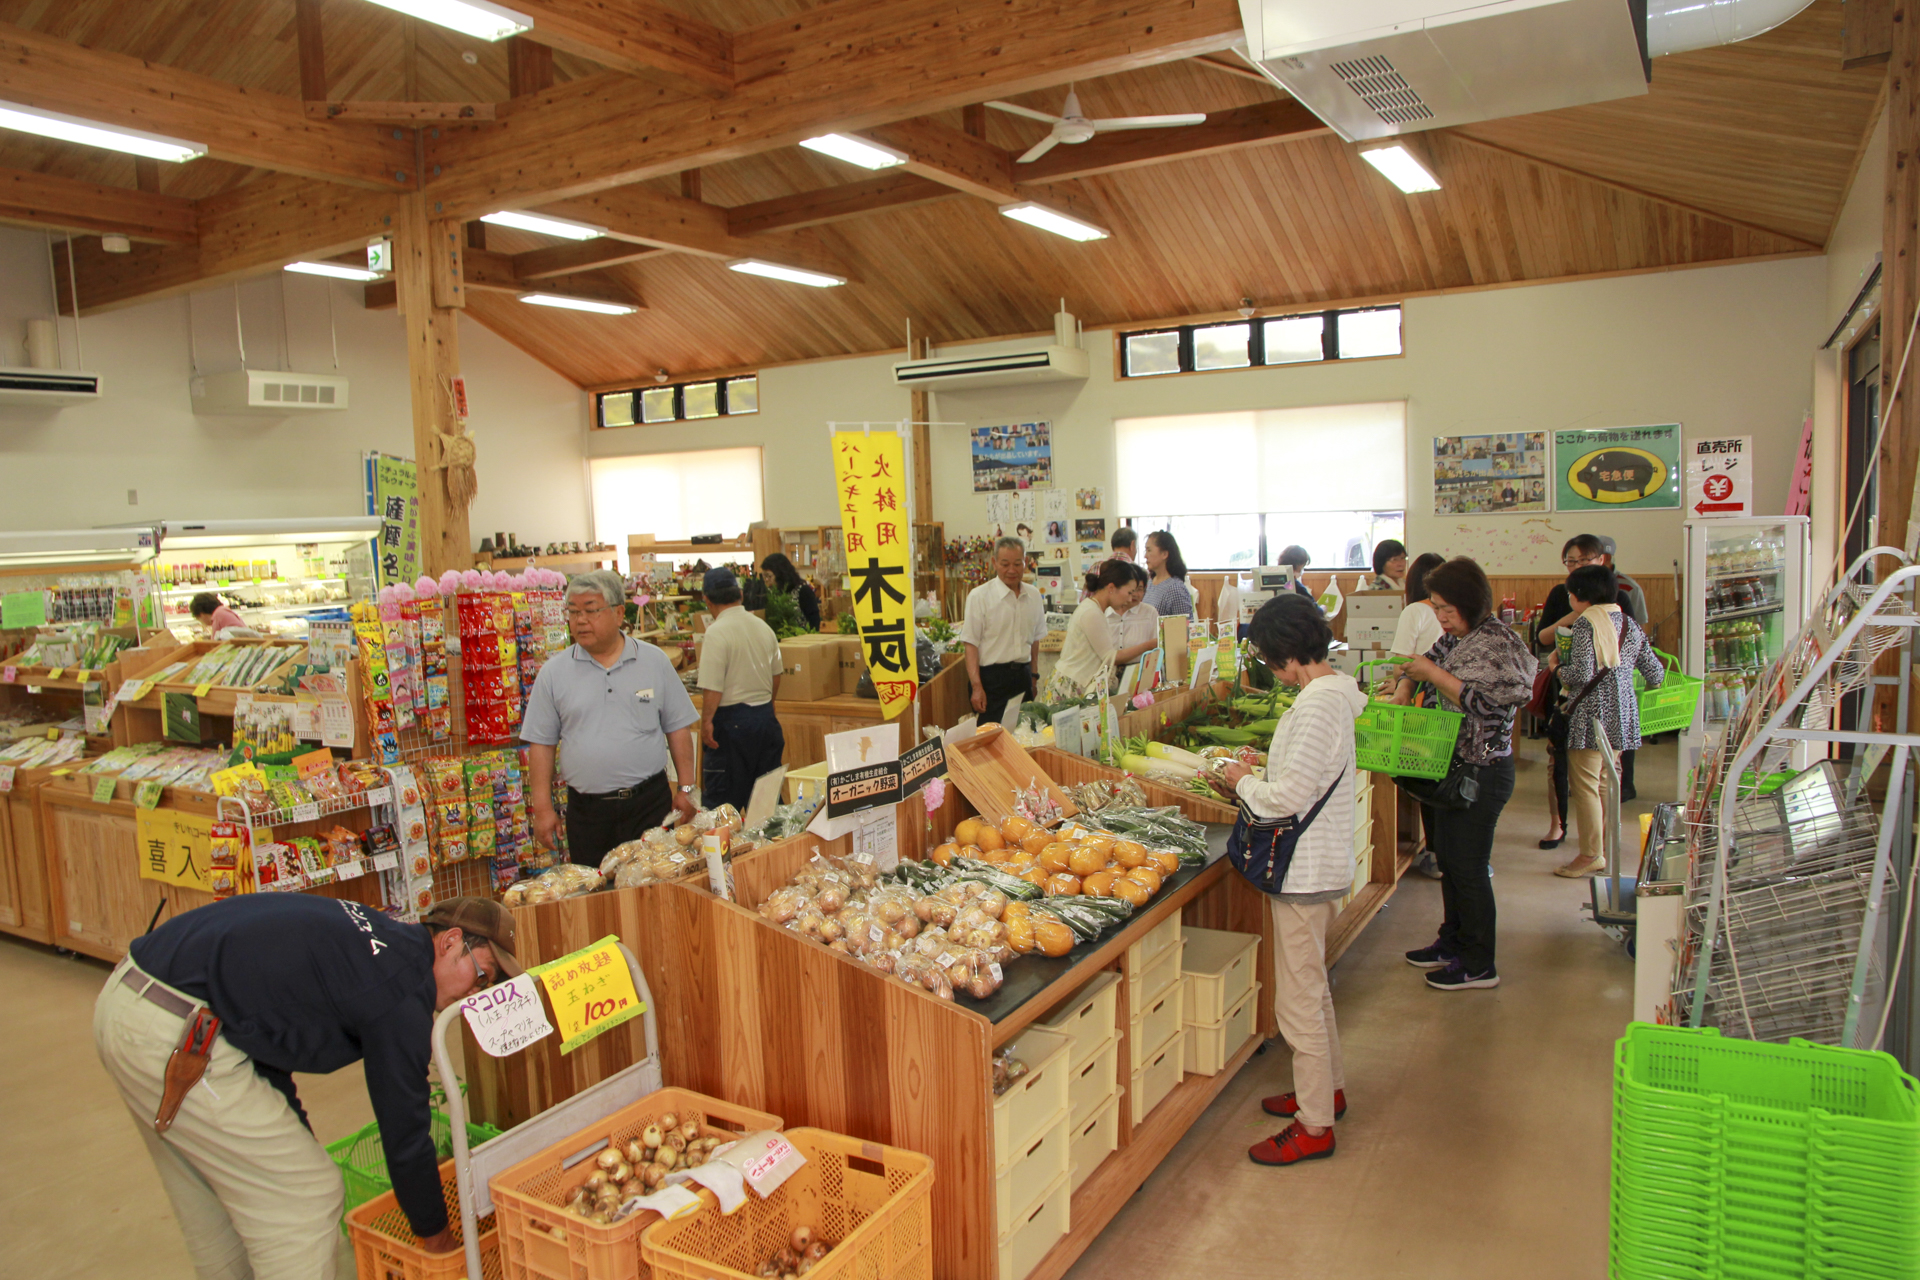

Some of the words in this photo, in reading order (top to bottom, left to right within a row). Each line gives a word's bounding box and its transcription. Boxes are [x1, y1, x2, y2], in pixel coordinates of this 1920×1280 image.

[1556, 428, 1673, 444] ここから荷物を送れます
[1697, 440, 1742, 455] 直売所
[1599, 469, 1635, 482] 宅急便
[1701, 457, 1738, 472] レジ
[383, 495, 406, 587] 薩摩名
[830, 766, 889, 787] (有)かごしま有機生産組合
[832, 775, 896, 801] オーガニック野菜
[147, 838, 201, 881] 喜入
[548, 951, 612, 991] 詰め放題
[460, 982, 523, 1014] ペコロス
[566, 973, 611, 1006] 玉ねぎ
[584, 997, 628, 1026] 100円
